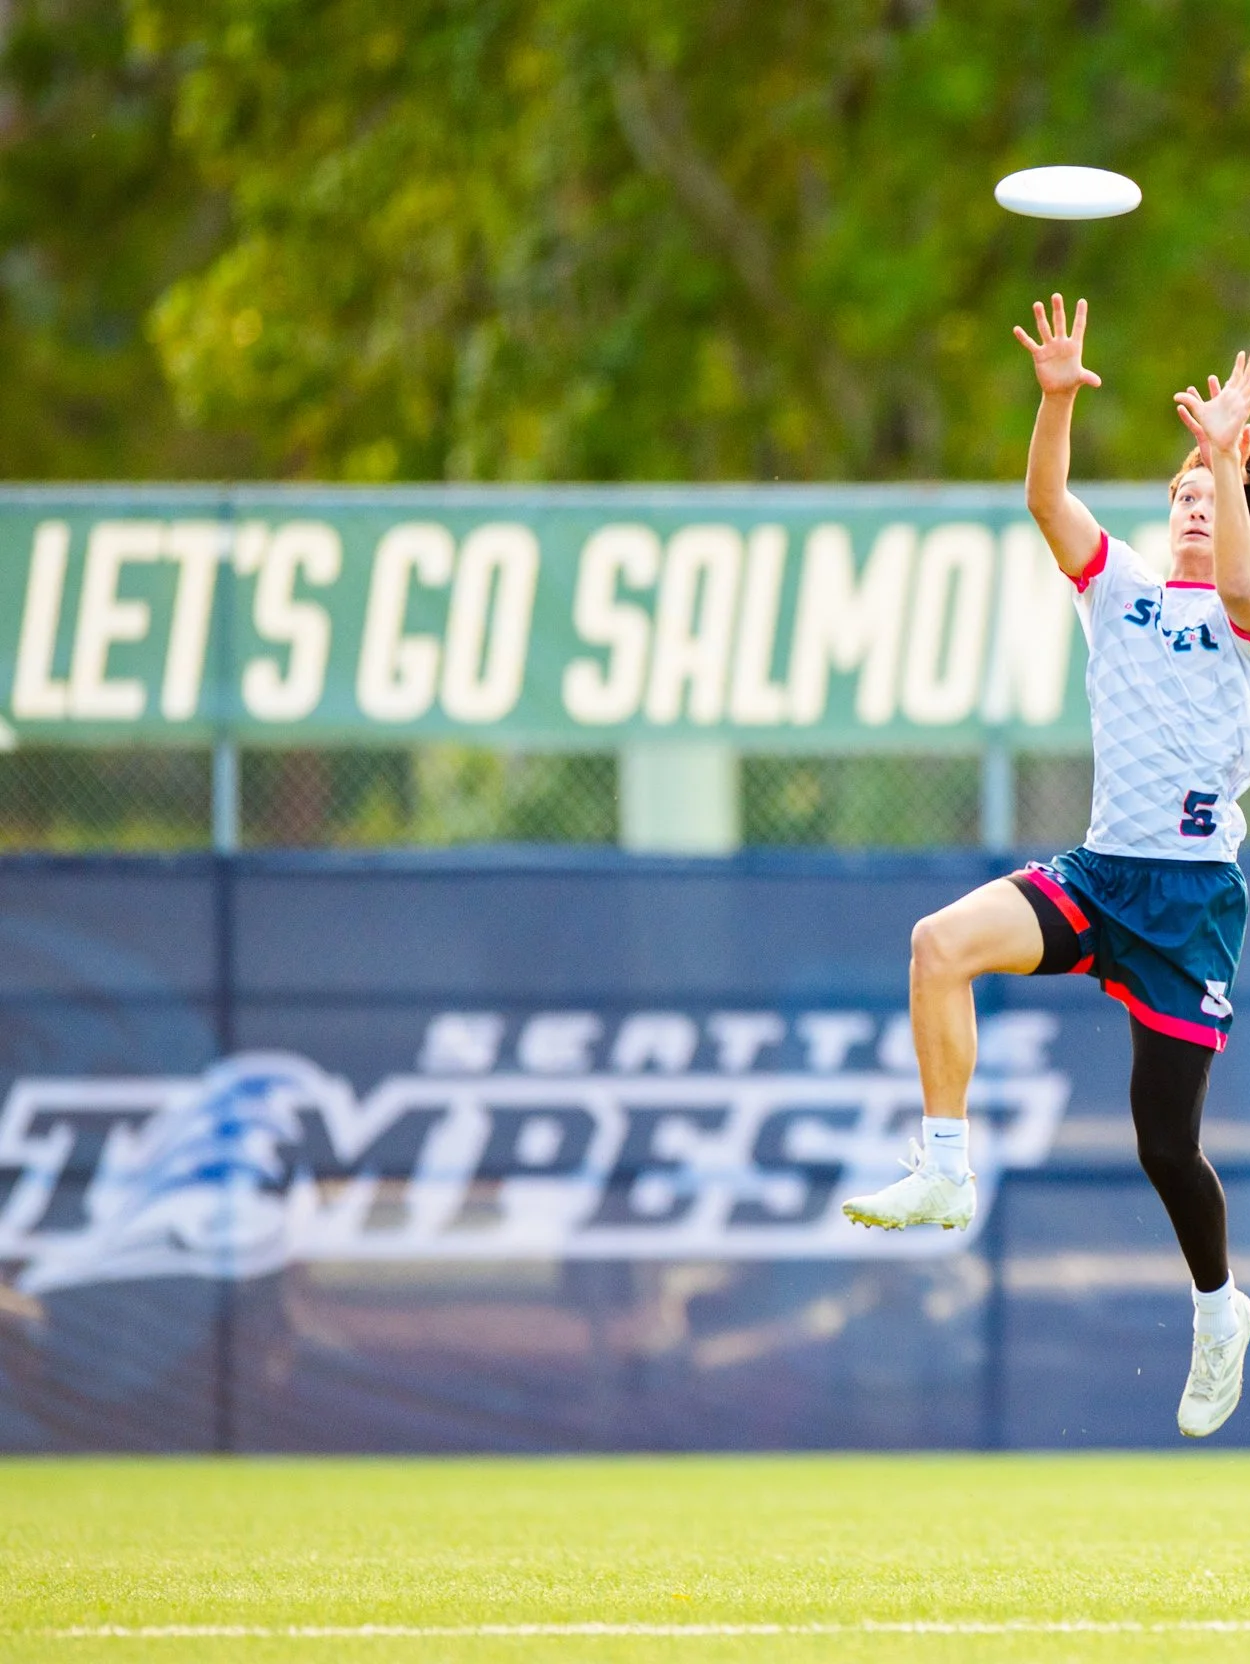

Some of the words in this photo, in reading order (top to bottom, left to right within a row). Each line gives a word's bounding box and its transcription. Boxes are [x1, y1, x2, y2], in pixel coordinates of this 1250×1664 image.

[10, 519, 343, 722] LET'S
[355, 521, 541, 724] GO
[562, 522, 1076, 727] SALMON
[1180, 789, 1219, 836] 5
